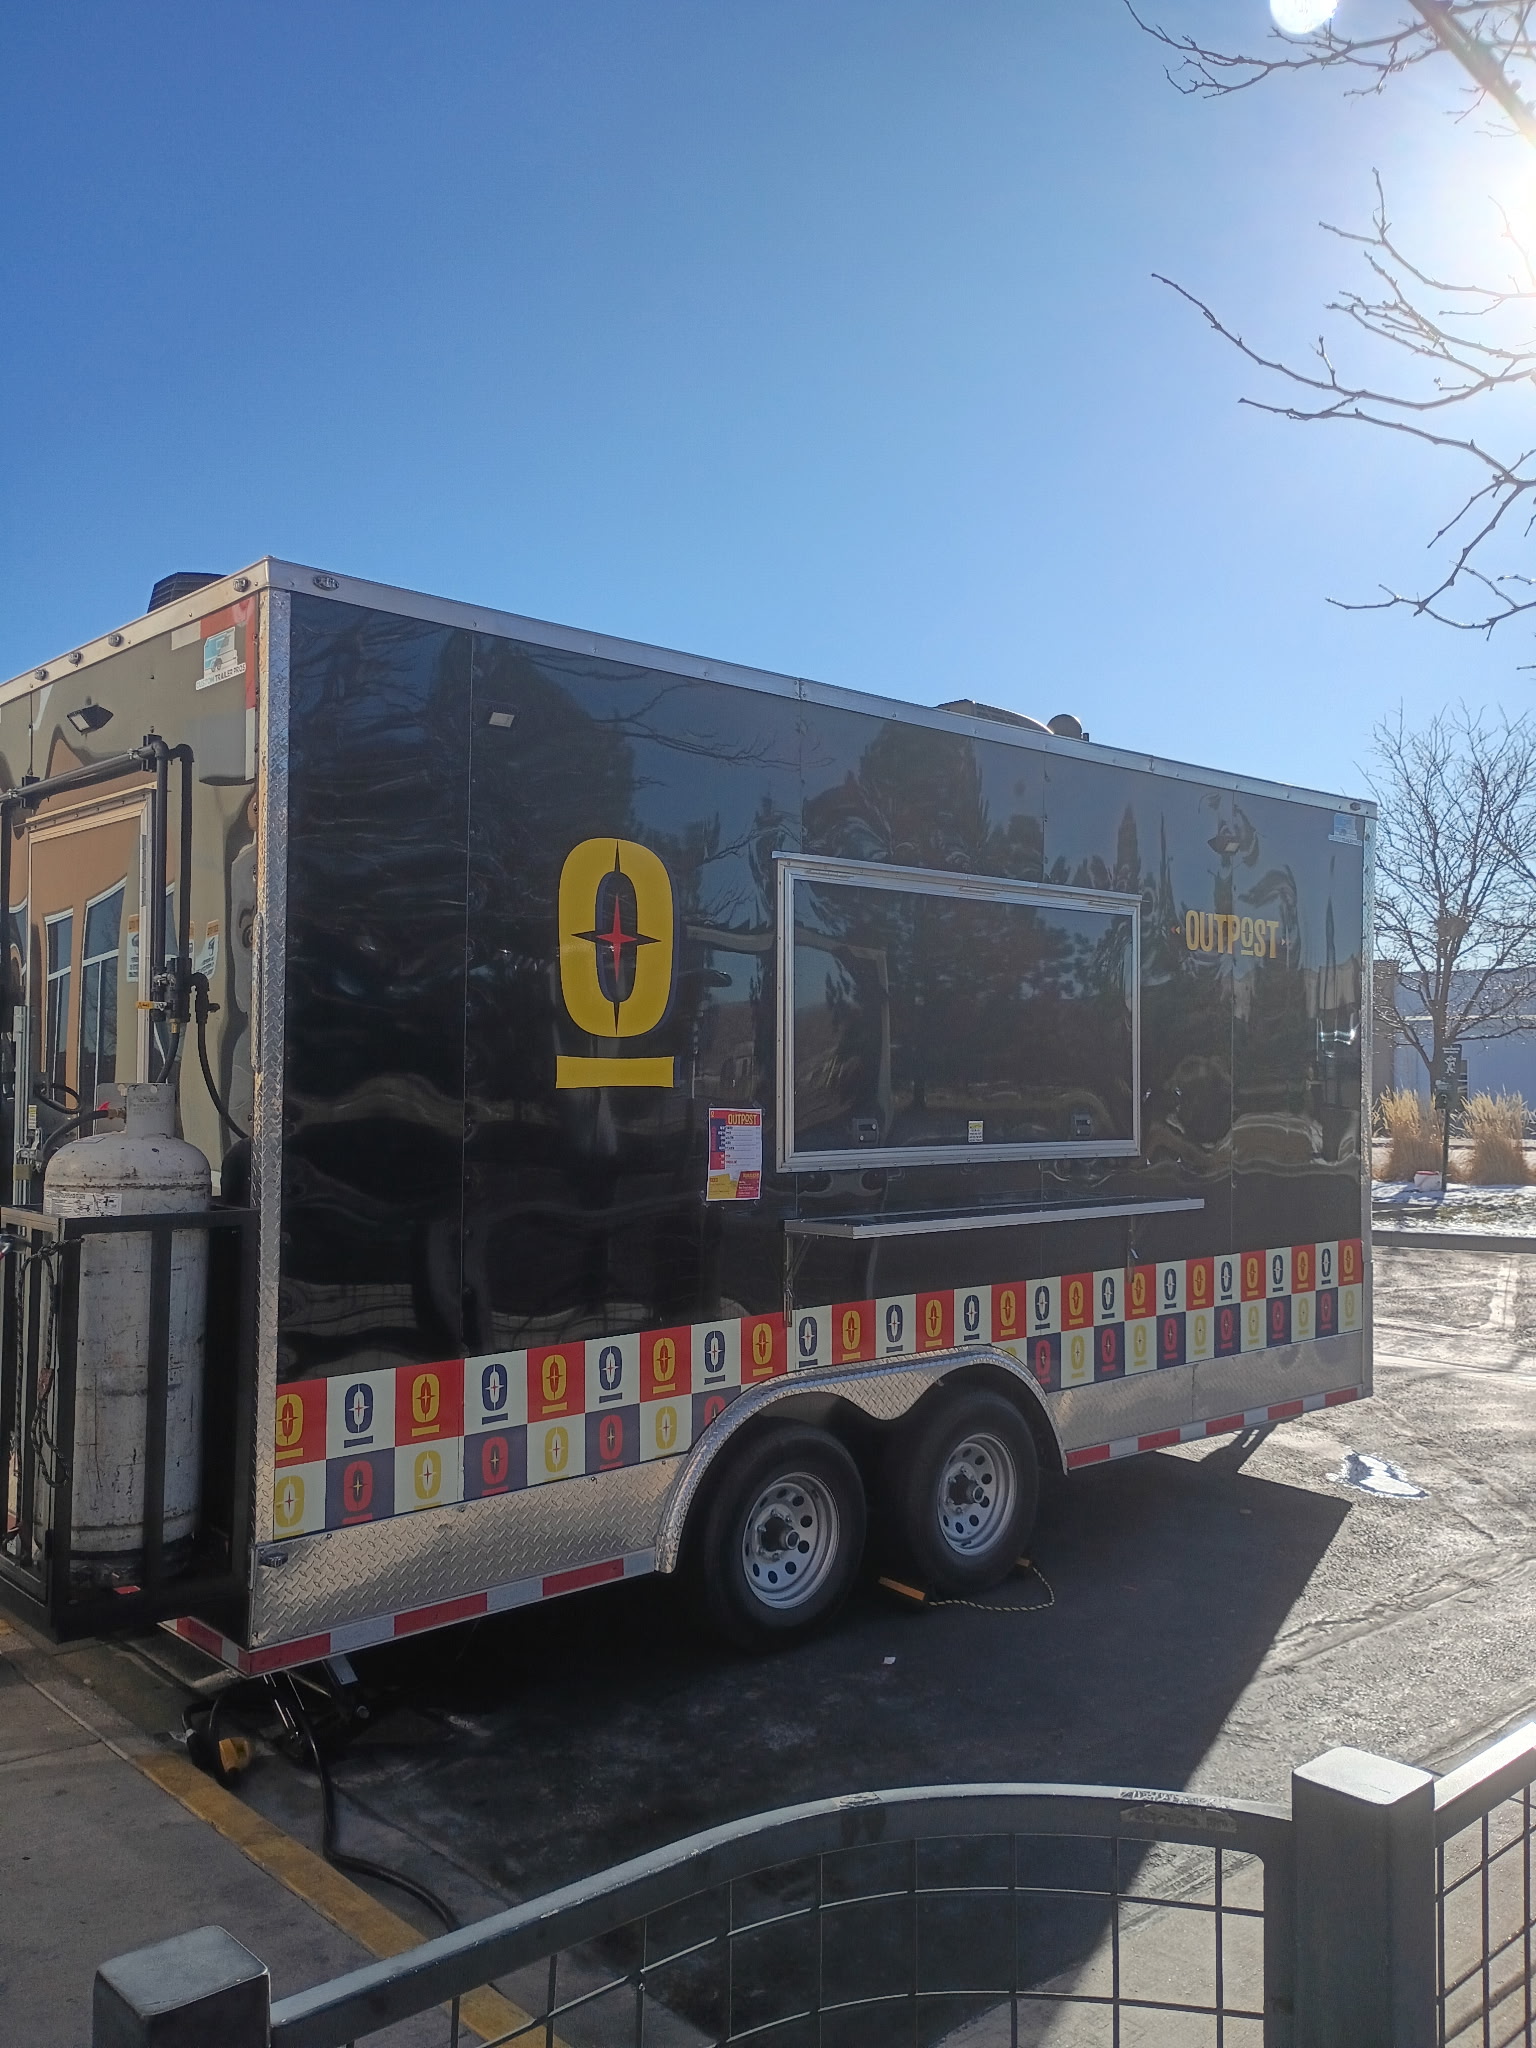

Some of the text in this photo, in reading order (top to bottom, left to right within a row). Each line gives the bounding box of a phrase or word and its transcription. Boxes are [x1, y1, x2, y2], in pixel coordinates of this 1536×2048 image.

[215, 668, 232, 681] TRAILER
[233, 664, 246, 674] PROS
[1185, 910, 1279, 958] OUTPOST
[728, 1114, 757, 1125] OUTPOST
